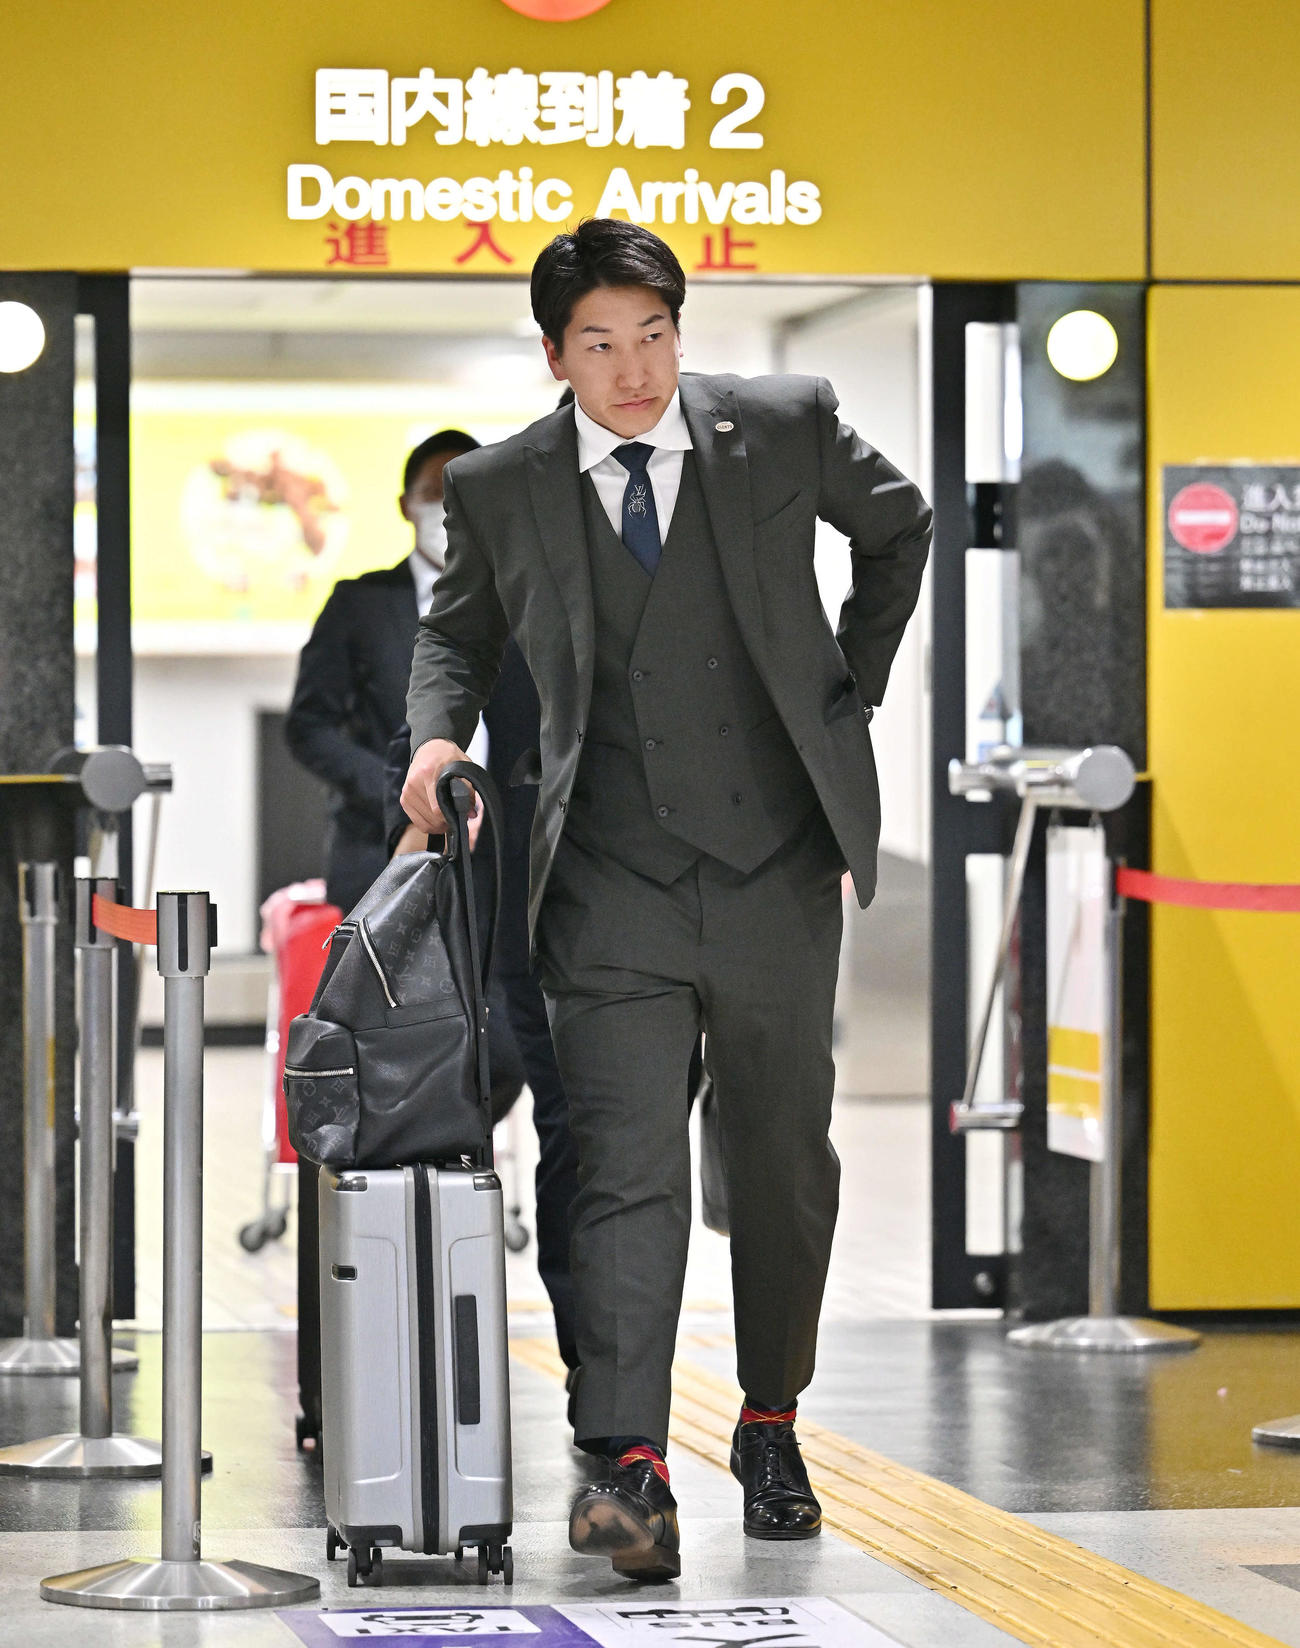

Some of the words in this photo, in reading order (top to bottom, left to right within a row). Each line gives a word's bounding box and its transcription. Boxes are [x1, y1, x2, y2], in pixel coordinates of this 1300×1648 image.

[315, 68, 691, 149] 国内線到着
[709, 73, 765, 149] 2
[287, 164, 574, 222] Domestic
[594, 168, 822, 226] Arrivals
[324, 222, 757, 271] 進入止
